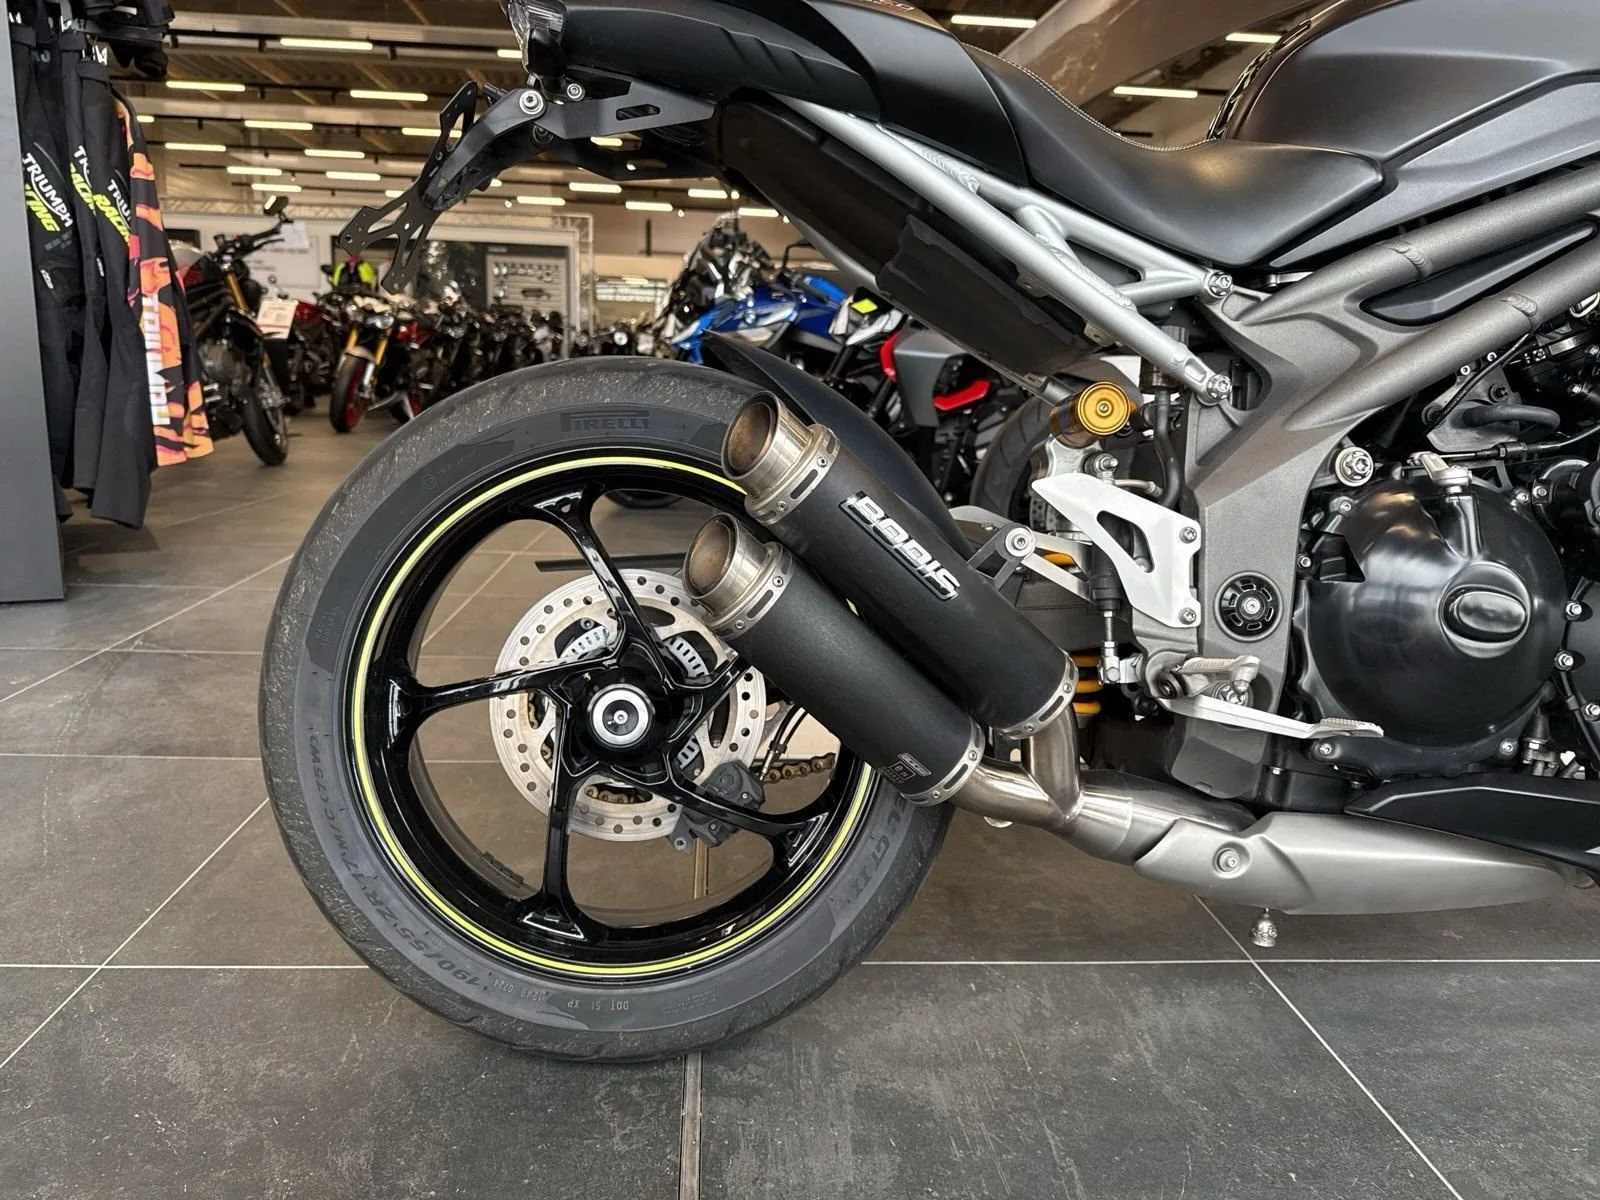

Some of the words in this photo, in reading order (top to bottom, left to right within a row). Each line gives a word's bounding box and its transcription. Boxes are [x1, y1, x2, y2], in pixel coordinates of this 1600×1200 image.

[22, 153, 73, 227] TRIUMPH
[561, 410, 650, 433] PIRELLI
[839, 490, 960, 601] BODIS
[567, 999, 580, 1008] XP
[610, 1000, 629, 1010] DOT
